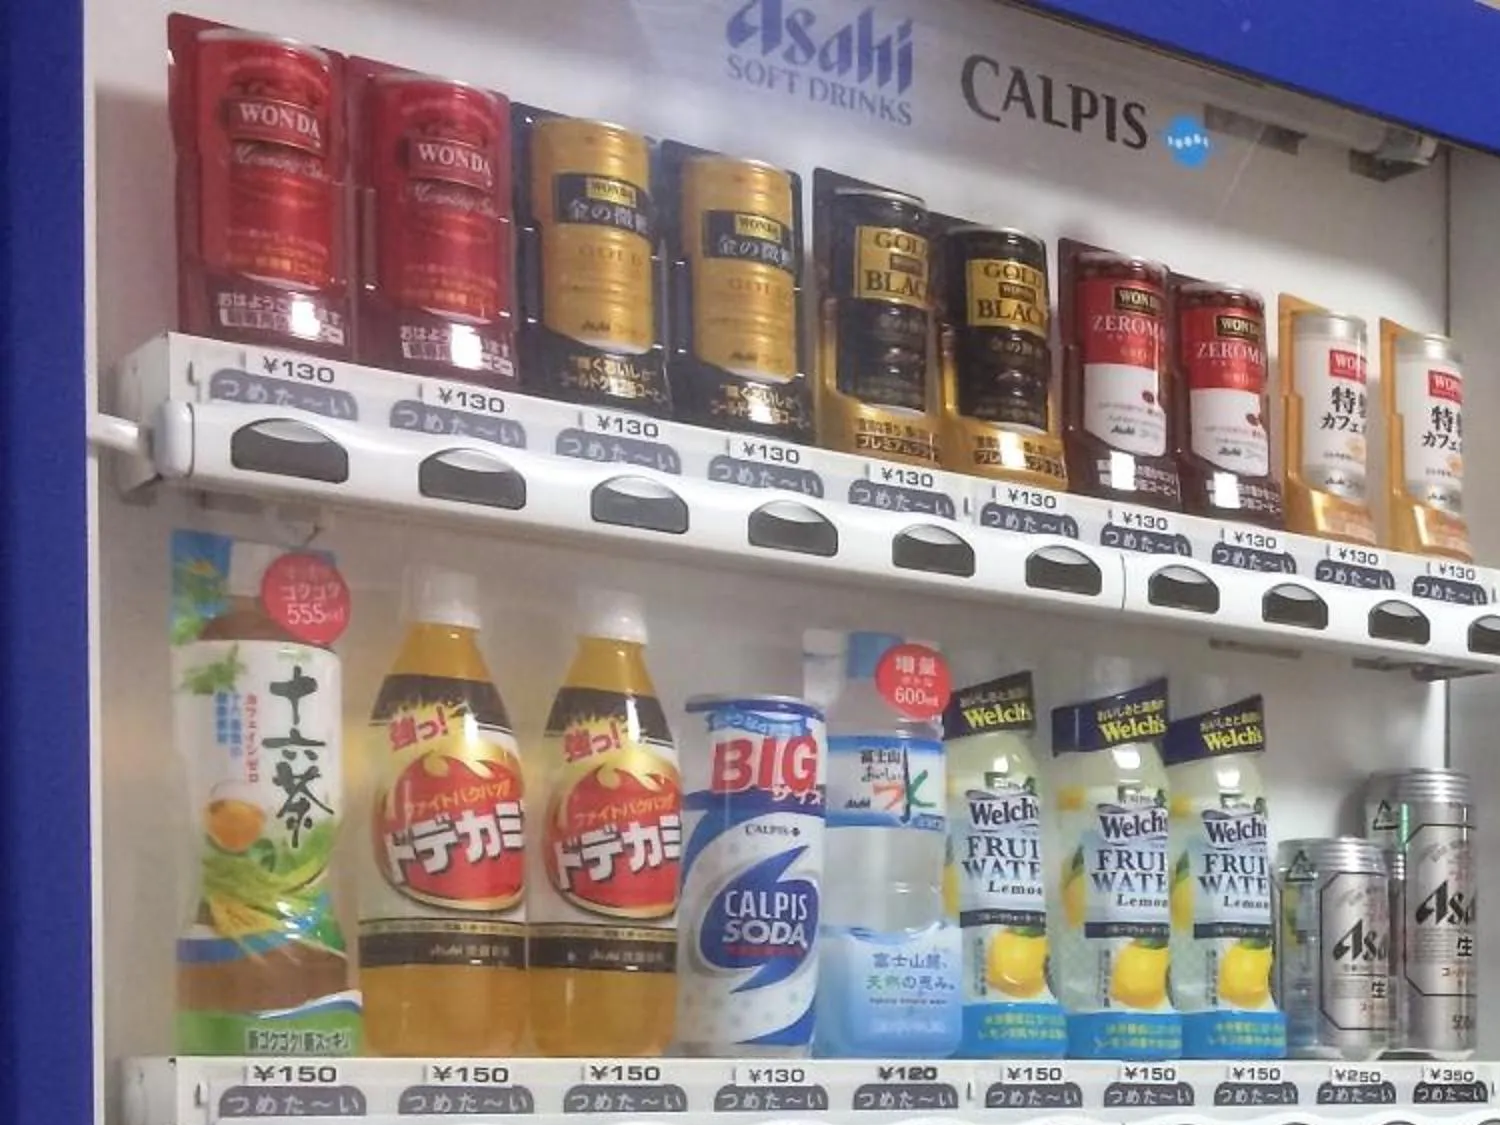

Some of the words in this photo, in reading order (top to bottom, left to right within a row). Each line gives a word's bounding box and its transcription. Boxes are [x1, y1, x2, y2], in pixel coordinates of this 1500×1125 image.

[726, 0, 913, 94] Asahi
[726, 55, 798, 97] SOFT
[809, 76, 912, 127] DRINKS
[961, 54, 1147, 150] CALPIS
[240, 102, 321, 138] WONDA
[419, 143, 492, 177] WONDA
[263, 355, 334, 384] ¥130
[438, 388, 504, 415] ¥130
[597, 415, 659, 438] ¥130
[1320, 412, 1365, 434] カフェ
[743, 441, 800, 464] ¥130
[1423, 432, 1462, 453] カフェ
[881, 468, 933, 489] ¥130
[1008, 489, 1057, 510] ¥130
[1122, 513, 1168, 531] ¥130
[1234, 532, 1277, 549] ¥130
[1338, 550, 1378, 565] ¥130
[1439, 565, 1476, 580] ¥130
[1100, 715, 1168, 743] Welch's
[1203, 728, 1263, 750] Welch's
[261, 666, 334, 849] 十六茶
[711, 736, 817, 794] BIG
[725, 890, 807, 920] CALPIS
[723, 919, 807, 948] SODA
[253, 1065, 338, 1083] ¥150
[432, 1065, 510, 1083] ¥150
[590, 1065, 661, 1082] ¥150
[748, 1068, 806, 1084] ¥130
[1007, 1067, 1062, 1081] ¥150
[1124, 1067, 1176, 1081] ¥150
[1231, 1067, 1281, 1081] ¥150
[1334, 1068, 1382, 1083] ¥250
[1429, 1068, 1475, 1082] ¥350
